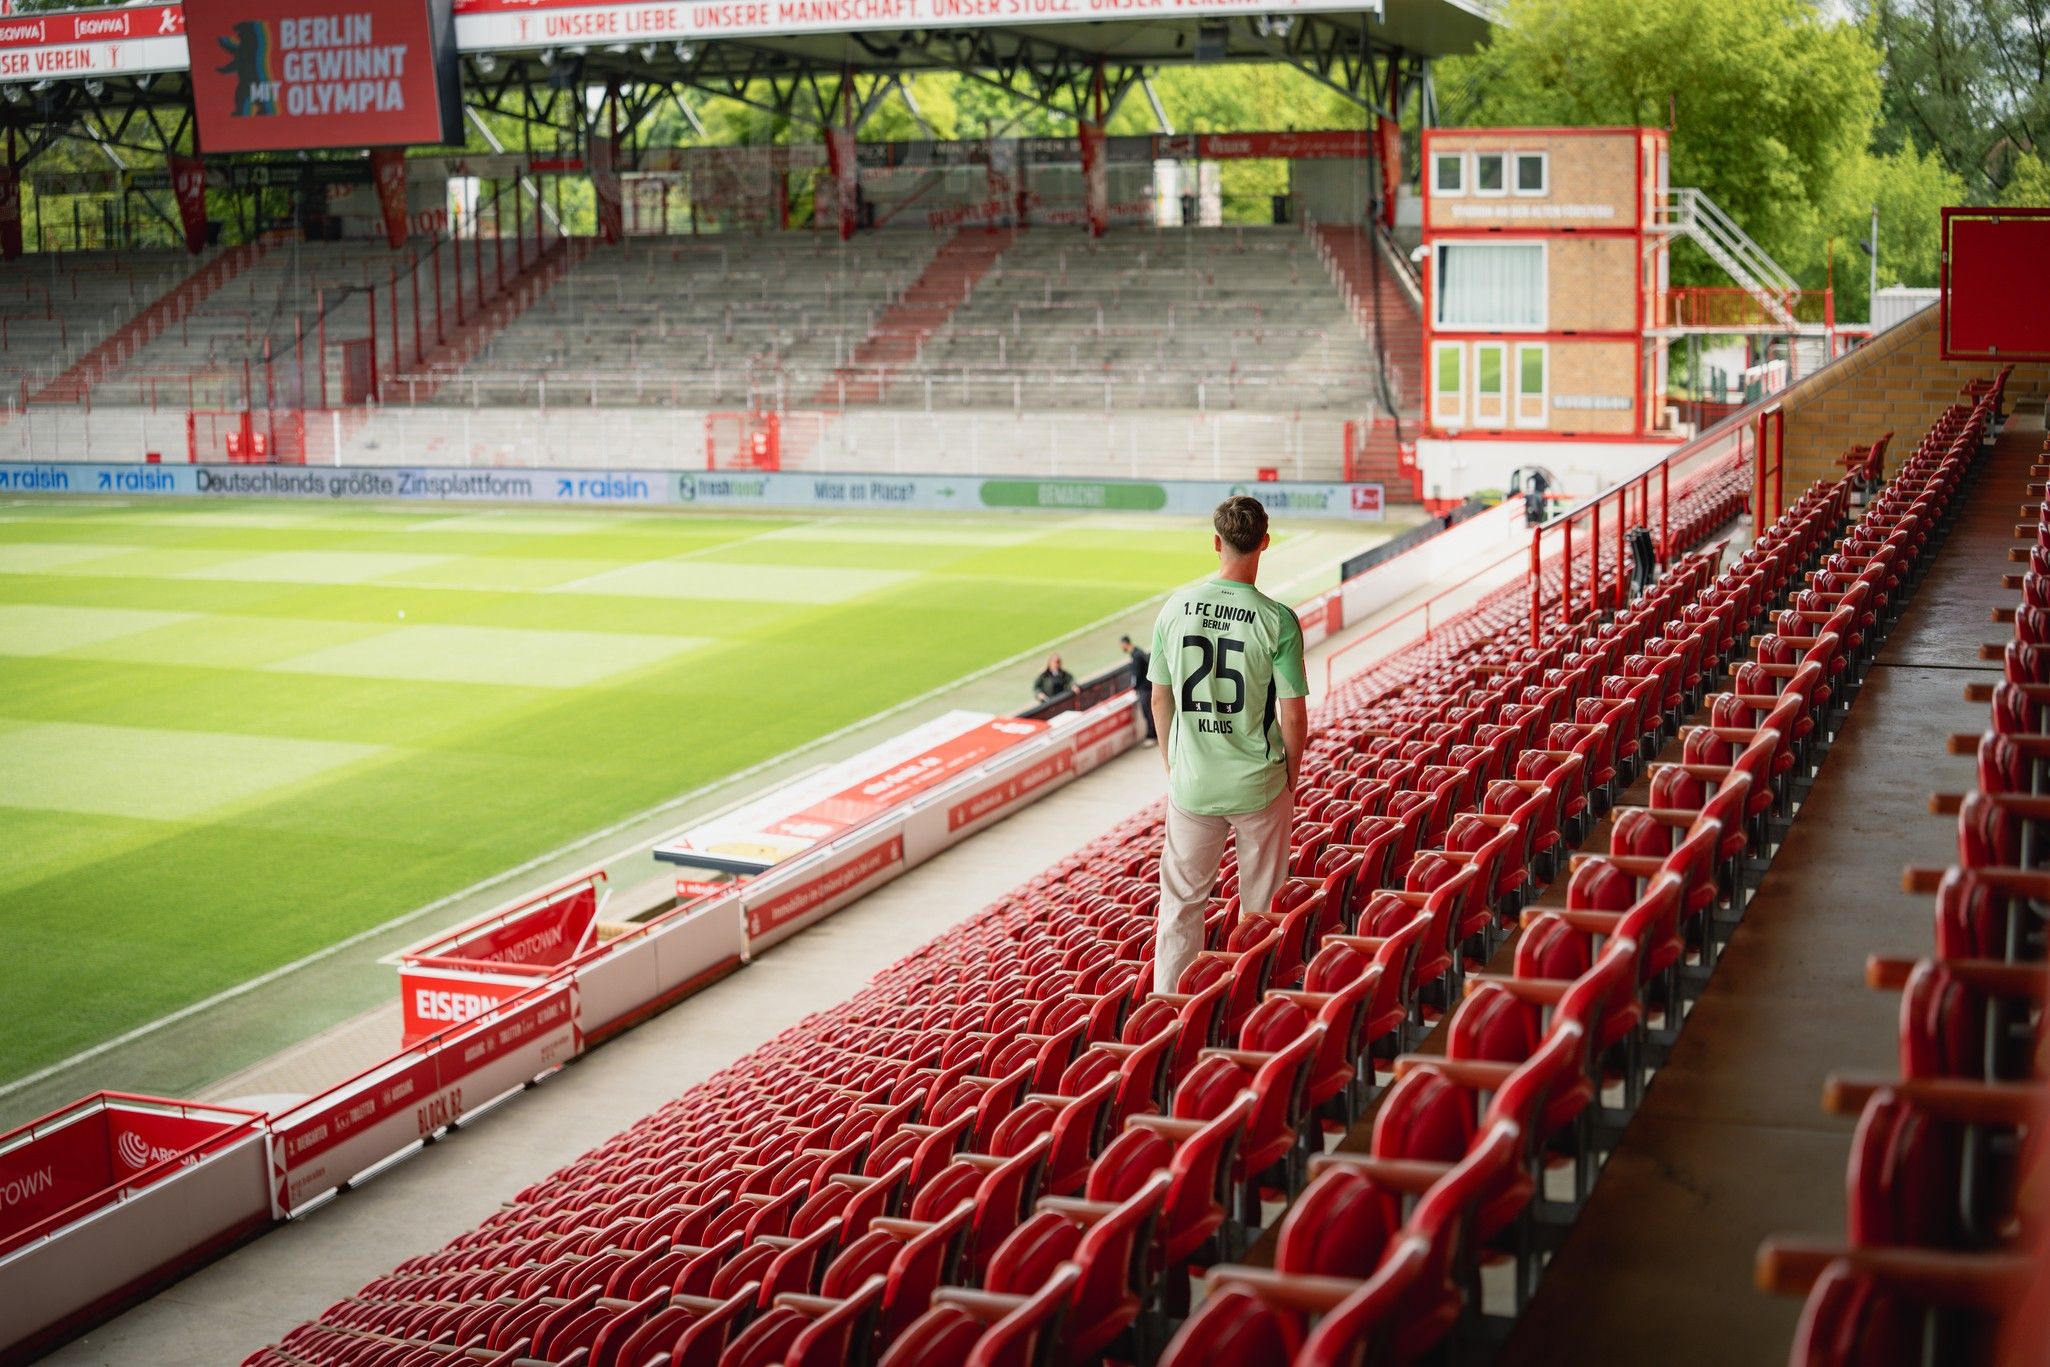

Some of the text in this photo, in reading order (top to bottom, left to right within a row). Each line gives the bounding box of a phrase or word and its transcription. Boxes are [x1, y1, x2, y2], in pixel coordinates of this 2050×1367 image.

[281, 13, 372, 49] BERLIN
[546, 14, 617, 37] UNSERE
[626, 8, 685, 33] LIEBE.
[693, 4, 768, 28] UNSERE
[779, 0, 923, 23] MANNSCHAFT.
[35, 48, 96, 72] VEREIN.
[283, 44, 407, 82] GEWINNT
[250, 79, 405, 116] MIT OLYMPIA
[13, 468, 69, 490] raisin
[116, 468, 174, 491] raisin
[196, 469, 532, 499] Deutschlands größte Zinsplattform
[578, 474, 649, 498] raisin
[1184, 602, 1256, 624] 1. FC UNION
[1202, 618, 1231, 631] BERLIN
[1182, 635, 1245, 714] 25
[1198, 718, 1233, 734] KLAUS
[416, 989, 499, 1024] EISERN
[417, 1094, 448, 1135] BLOCK
